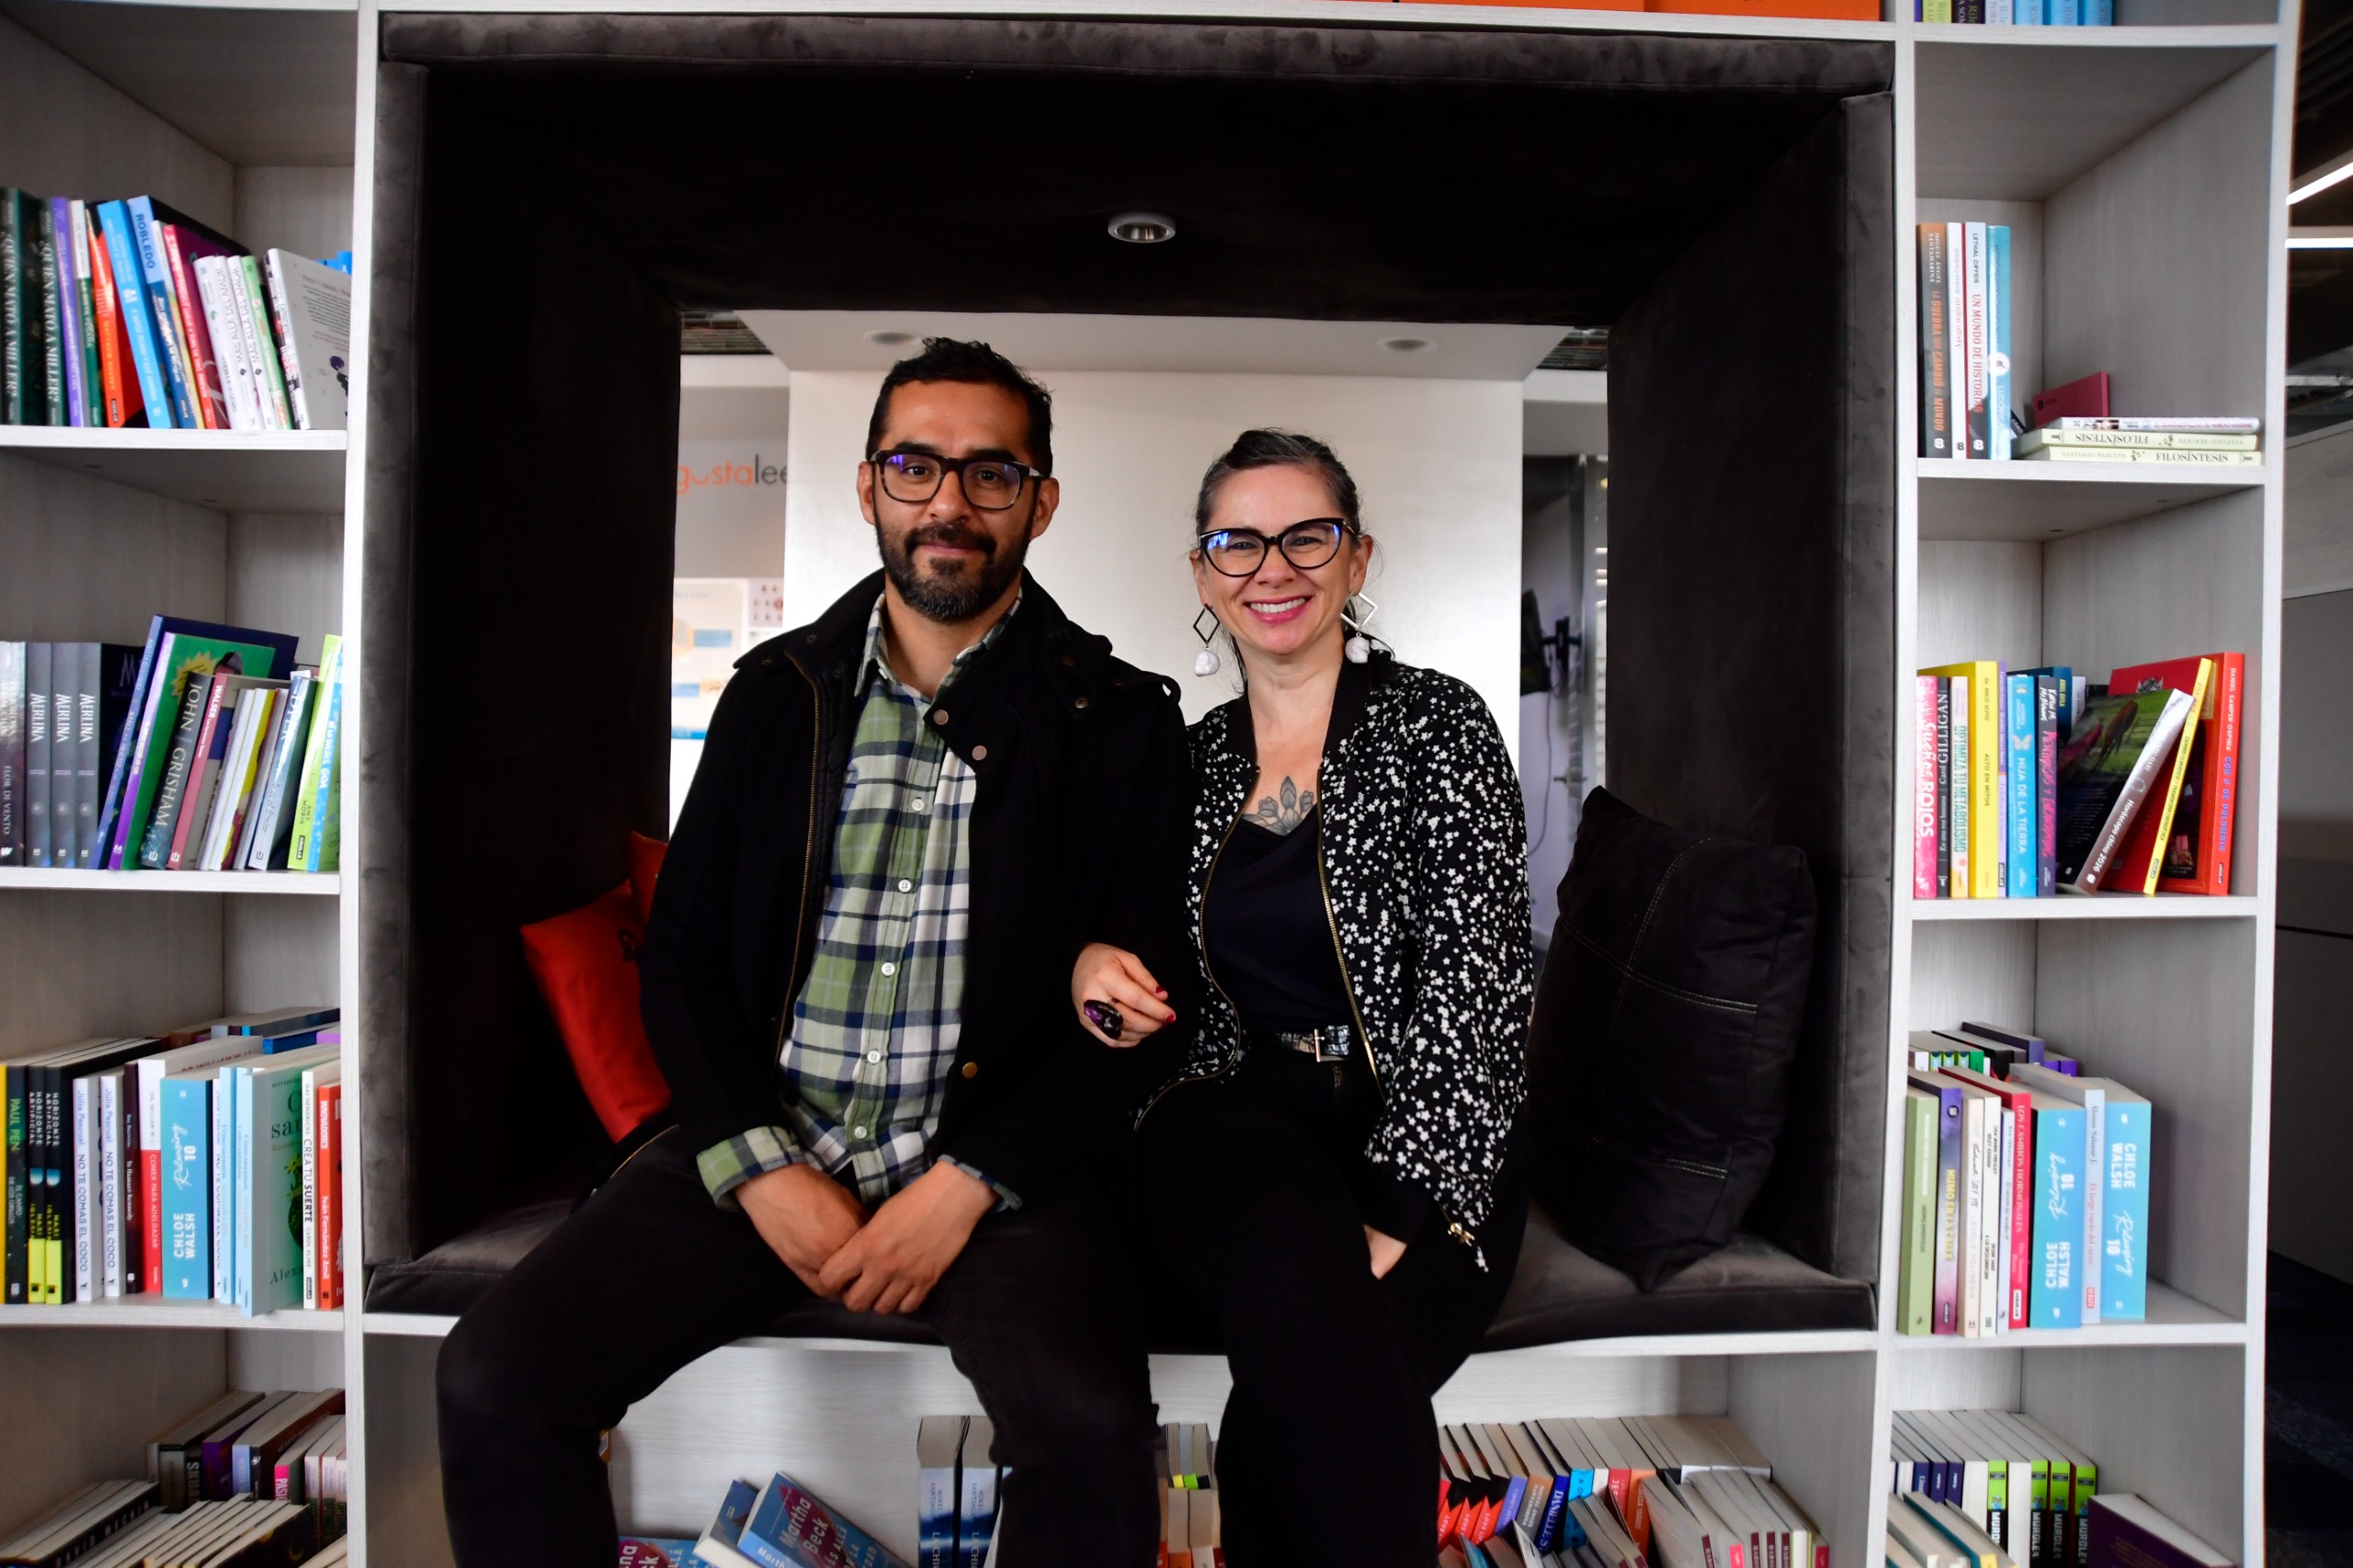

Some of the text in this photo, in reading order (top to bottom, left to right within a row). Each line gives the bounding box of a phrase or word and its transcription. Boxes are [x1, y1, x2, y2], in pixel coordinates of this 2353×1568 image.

[134, 212, 155, 269] ROBLEDO
[214, 267, 233, 315] DEL AMOR
[231, 267, 249, 315] DEL AMOR
[1, 232, 17, 397] ¿QUIÉN MATÓ A MILLER?
[40, 241, 59, 402] ¿QUIÉN MATÓ A MILLER?
[1930, 301, 1940, 334] GUERRA
[169, 354, 182, 382] lengua
[1932, 351, 1943, 385] CAMBIÓ
[1971, 293, 1984, 413] UN MUNDO DE HISTORIAS
[1933, 397, 1944, 430] MUNDO
[2075, 432, 2147, 445] FILOSÍNTESIS
[2155, 449, 2228, 462] FILOSÍNTESIS
[29, 693, 46, 742] MERLINA
[54, 693, 72, 742] MERLINA
[78, 694, 96, 743] MERLINA
[208, 684, 223, 718] WALSER
[2226, 694, 2234, 722] SAMPER
[1938, 694, 1948, 763] GILLIGAN
[2224, 723, 2233, 751] OSPINA
[153, 682, 203, 827] JOHN GRISHAM
[2, 766, 11, 834] FLOR DI VENTO
[318, 767, 329, 789] GOA
[1954, 725, 1965, 851] OPTIMIZA TU METABOLISMO
[2222, 788, 2229, 800] DE
[299, 799, 307, 824] MORIN
[1919, 781, 1933, 836] ROJOS
[2018, 757, 2026, 853] HIJA DE LA TIERRA
[2219, 803, 2228, 851] POLOMBIA
[2092, 798, 2134, 872] Horóscopo chino 2026
[9, 1098, 20, 1150] PAUL PEN
[76, 1113, 85, 1145] Pascual
[104, 1110, 113, 1142] Pascual
[320, 1100, 328, 1148] INNOVADORES
[2090, 1105, 2098, 1128] Alonso
[171, 1123, 191, 1189] Releasing
[183, 1145, 196, 1161] 10
[2089, 1131, 2097, 1156] Salazar
[2110, 1142, 2123, 1188] WALSH
[2122, 1142, 2136, 1188] CHLOE
[303, 1139, 312, 1221] CREA TU SUERTE
[1945, 1169, 1956, 1214] HUMO EN
[2014, 1105, 2025, 1233] LOS CAMBIOS HORMONALES
[2046, 1151, 2070, 1220] Releasing
[2061, 1173, 2074, 1190] 10
[76, 1153, 87, 1271] NO TE COMAS EL COCO
[104, 1151, 115, 1267] NO TE COMAS EL COCO
[2087, 1192, 2096, 1210] largo
[2087, 1212, 2096, 1231] vuelo
[173, 1212, 184, 1257] CHLOE
[184, 1212, 195, 1258] WALSH
[321, 1215, 329, 1260] Fernández
[2086, 1233, 2095, 1244] del
[2106, 1238, 2120, 1256] 10
[2110, 1210, 2135, 1278] Releasing
[2044, 1242, 2058, 1288] CHLOE
[2057, 1241, 2070, 1288] WALSH
[779, 1496, 812, 1549] Martha
[802, 1517, 829, 1555] Beck
[1991, 1512, 2000, 1544] MURD
